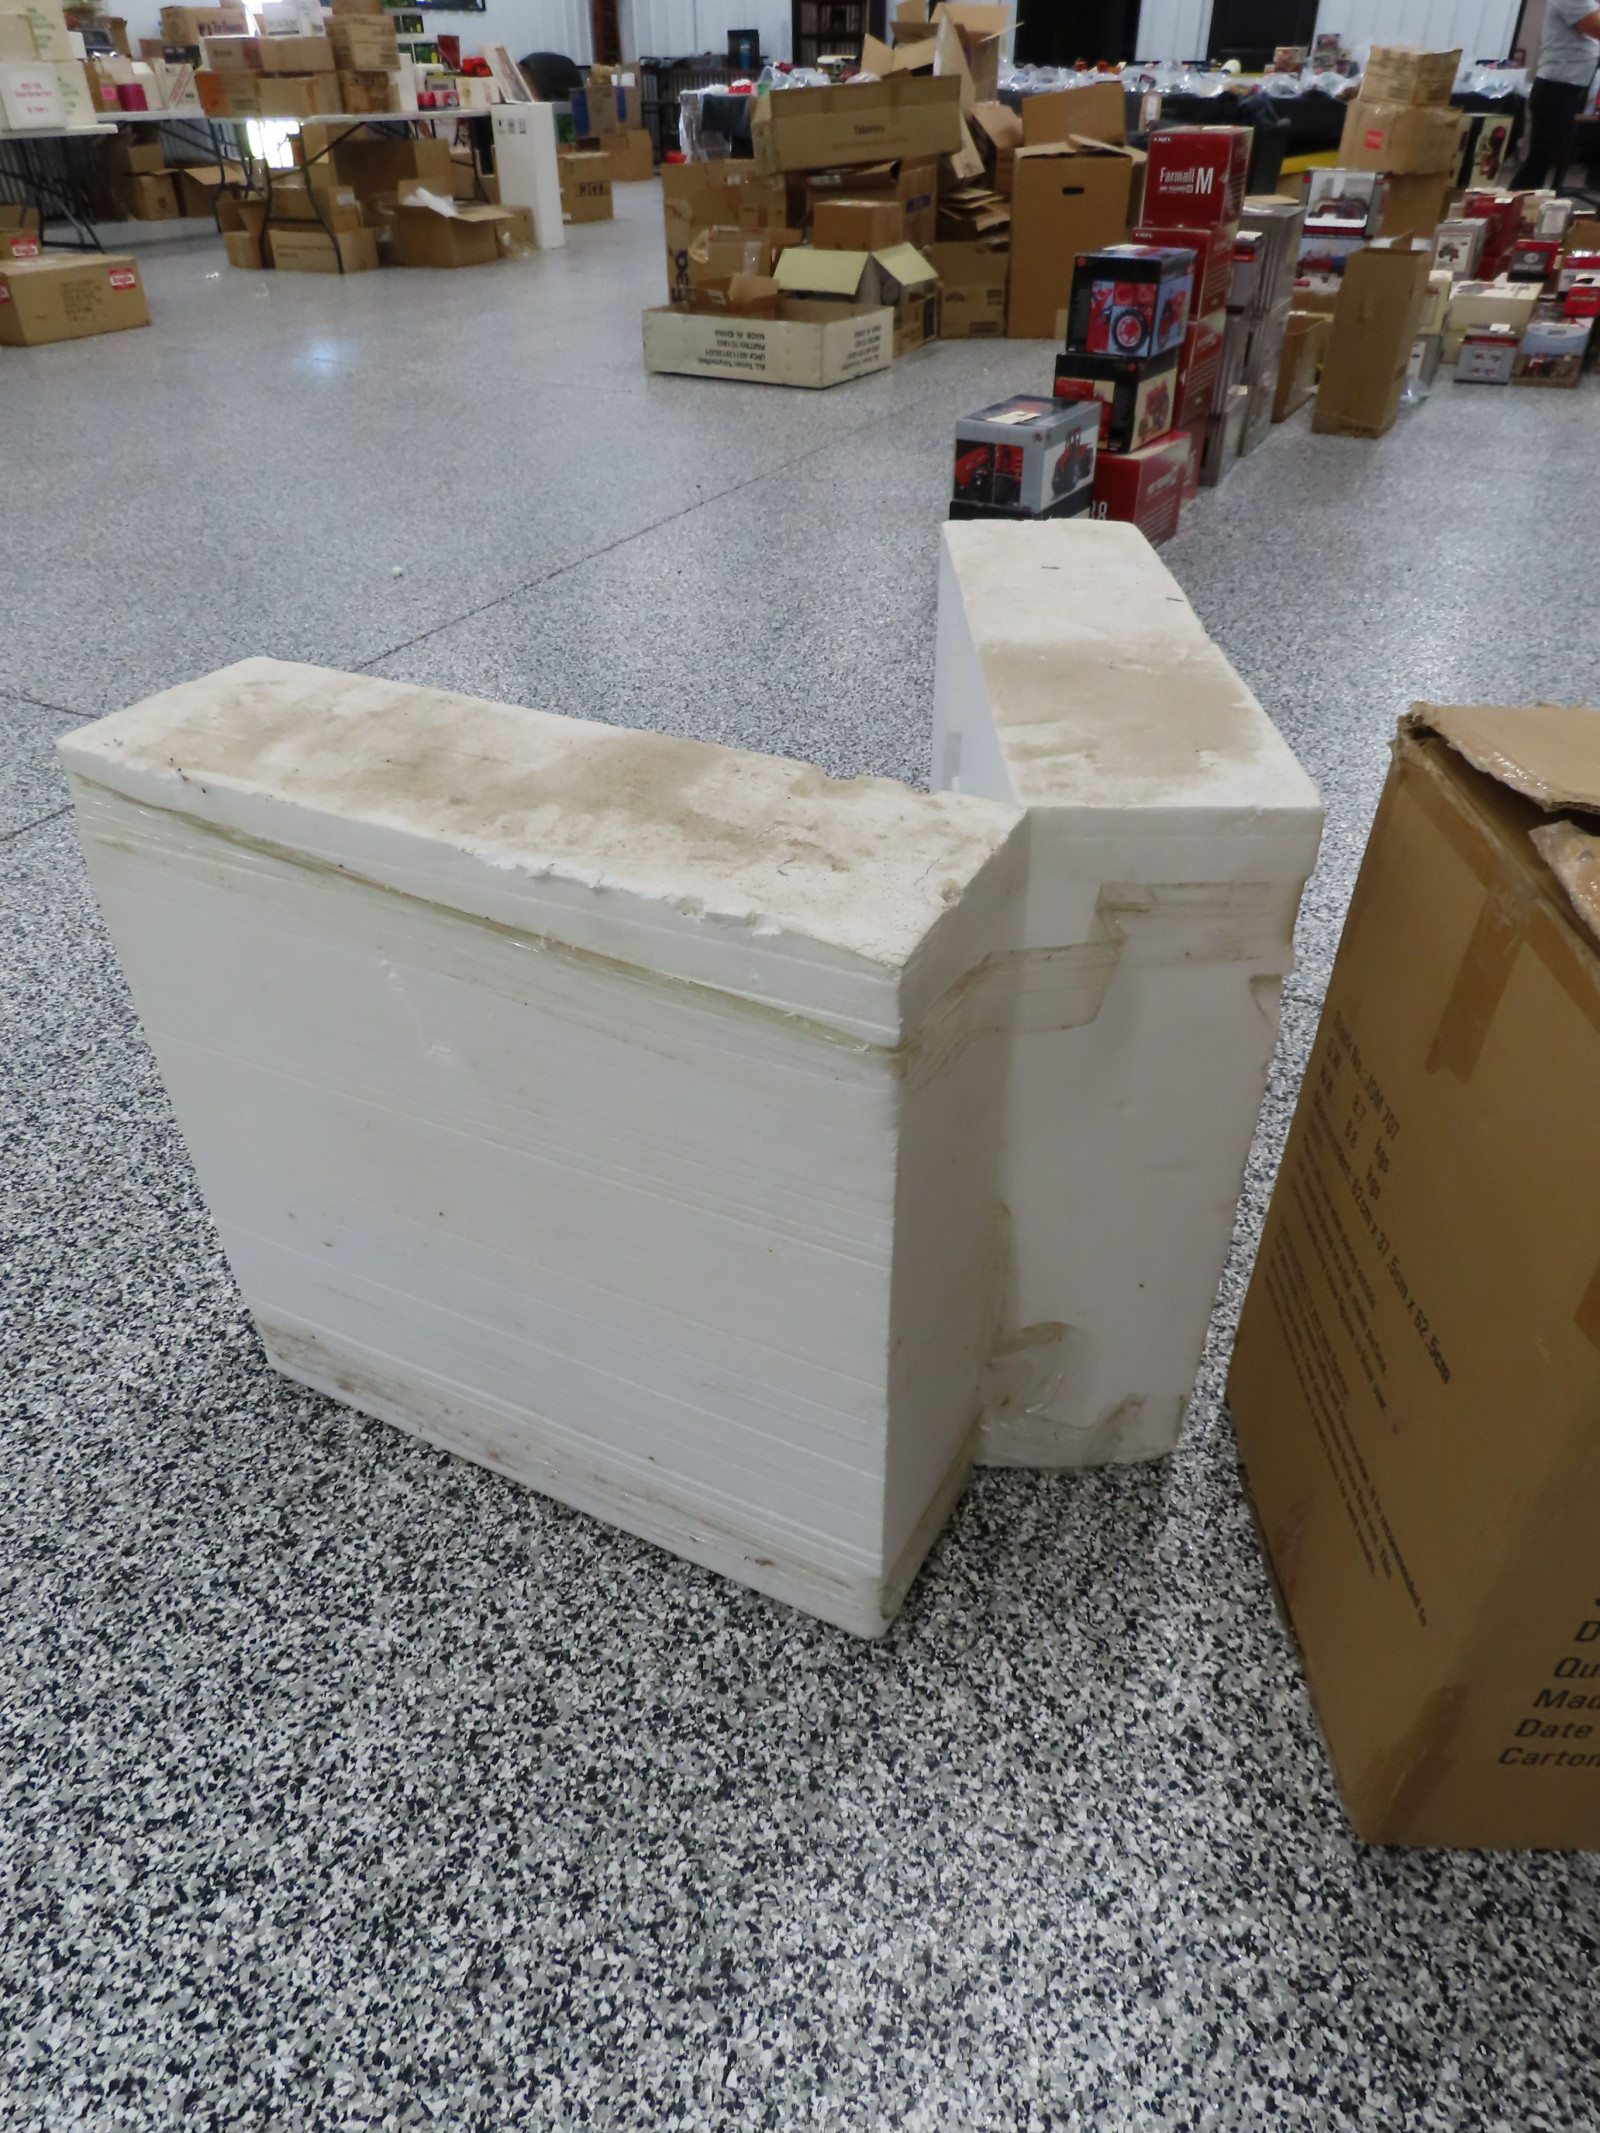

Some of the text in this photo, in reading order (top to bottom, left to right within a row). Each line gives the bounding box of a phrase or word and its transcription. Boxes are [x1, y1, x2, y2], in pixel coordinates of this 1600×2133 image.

[1160, 167, 1196, 183] Farmall
[1195, 167, 1214, 194] M
[1381, 1105, 1400, 1139] 707
[1374, 1137, 1389, 1173] kgs
[1365, 1165, 1381, 1200] kgs
[1514, 1718, 1593, 1739] Date
